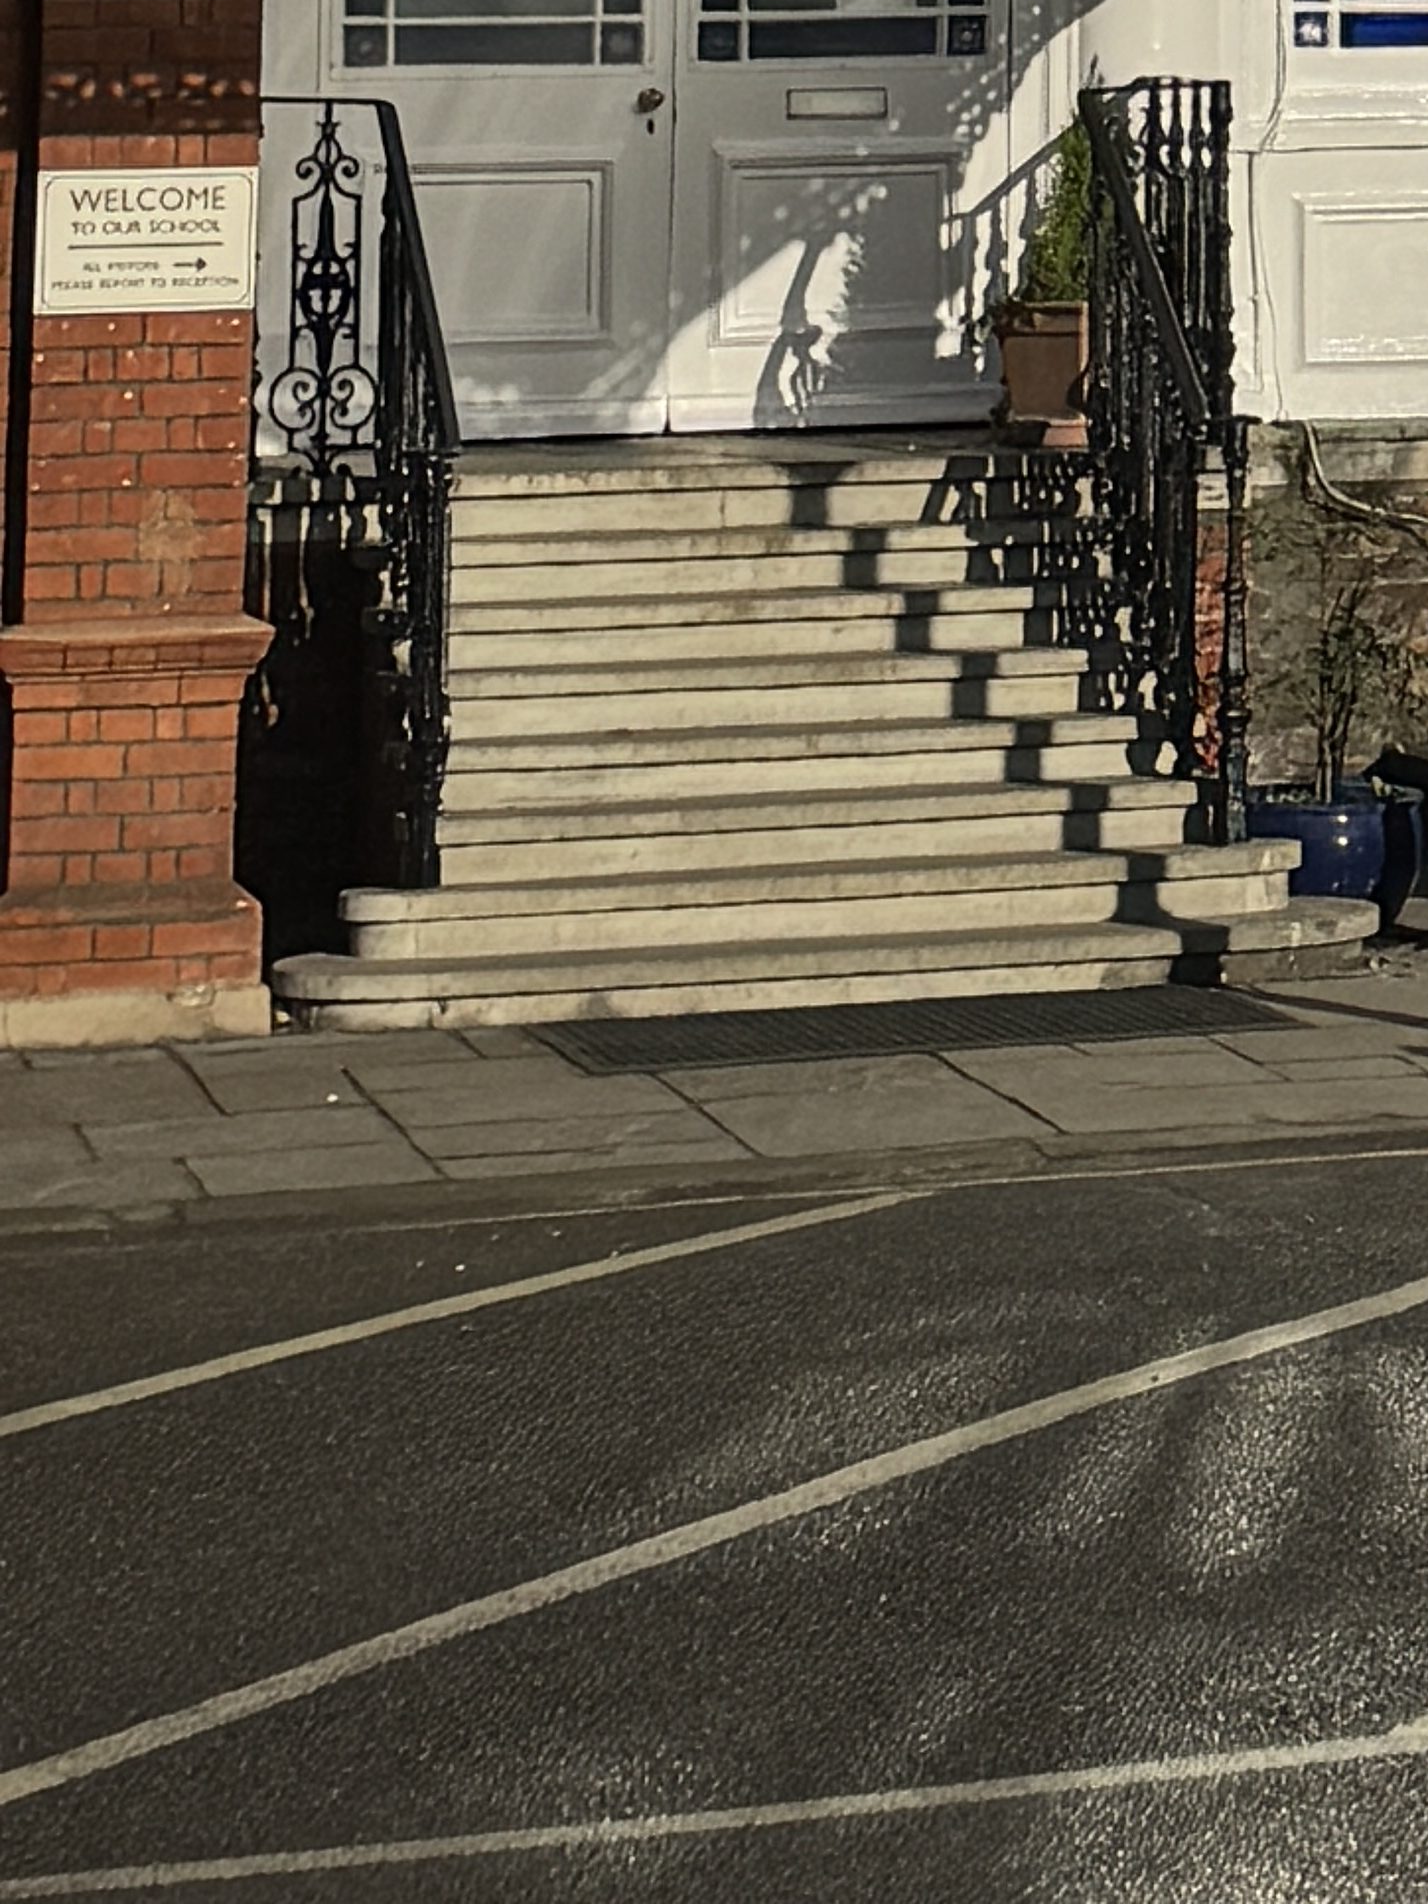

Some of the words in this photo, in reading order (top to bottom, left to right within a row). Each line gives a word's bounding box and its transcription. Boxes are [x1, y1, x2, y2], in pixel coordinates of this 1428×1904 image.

[70, 186, 226, 211] WELCOME
[71, 221, 96, 235] TO
[102, 220, 141, 235] OUR
[150, 218, 221, 233] SCHOOL
